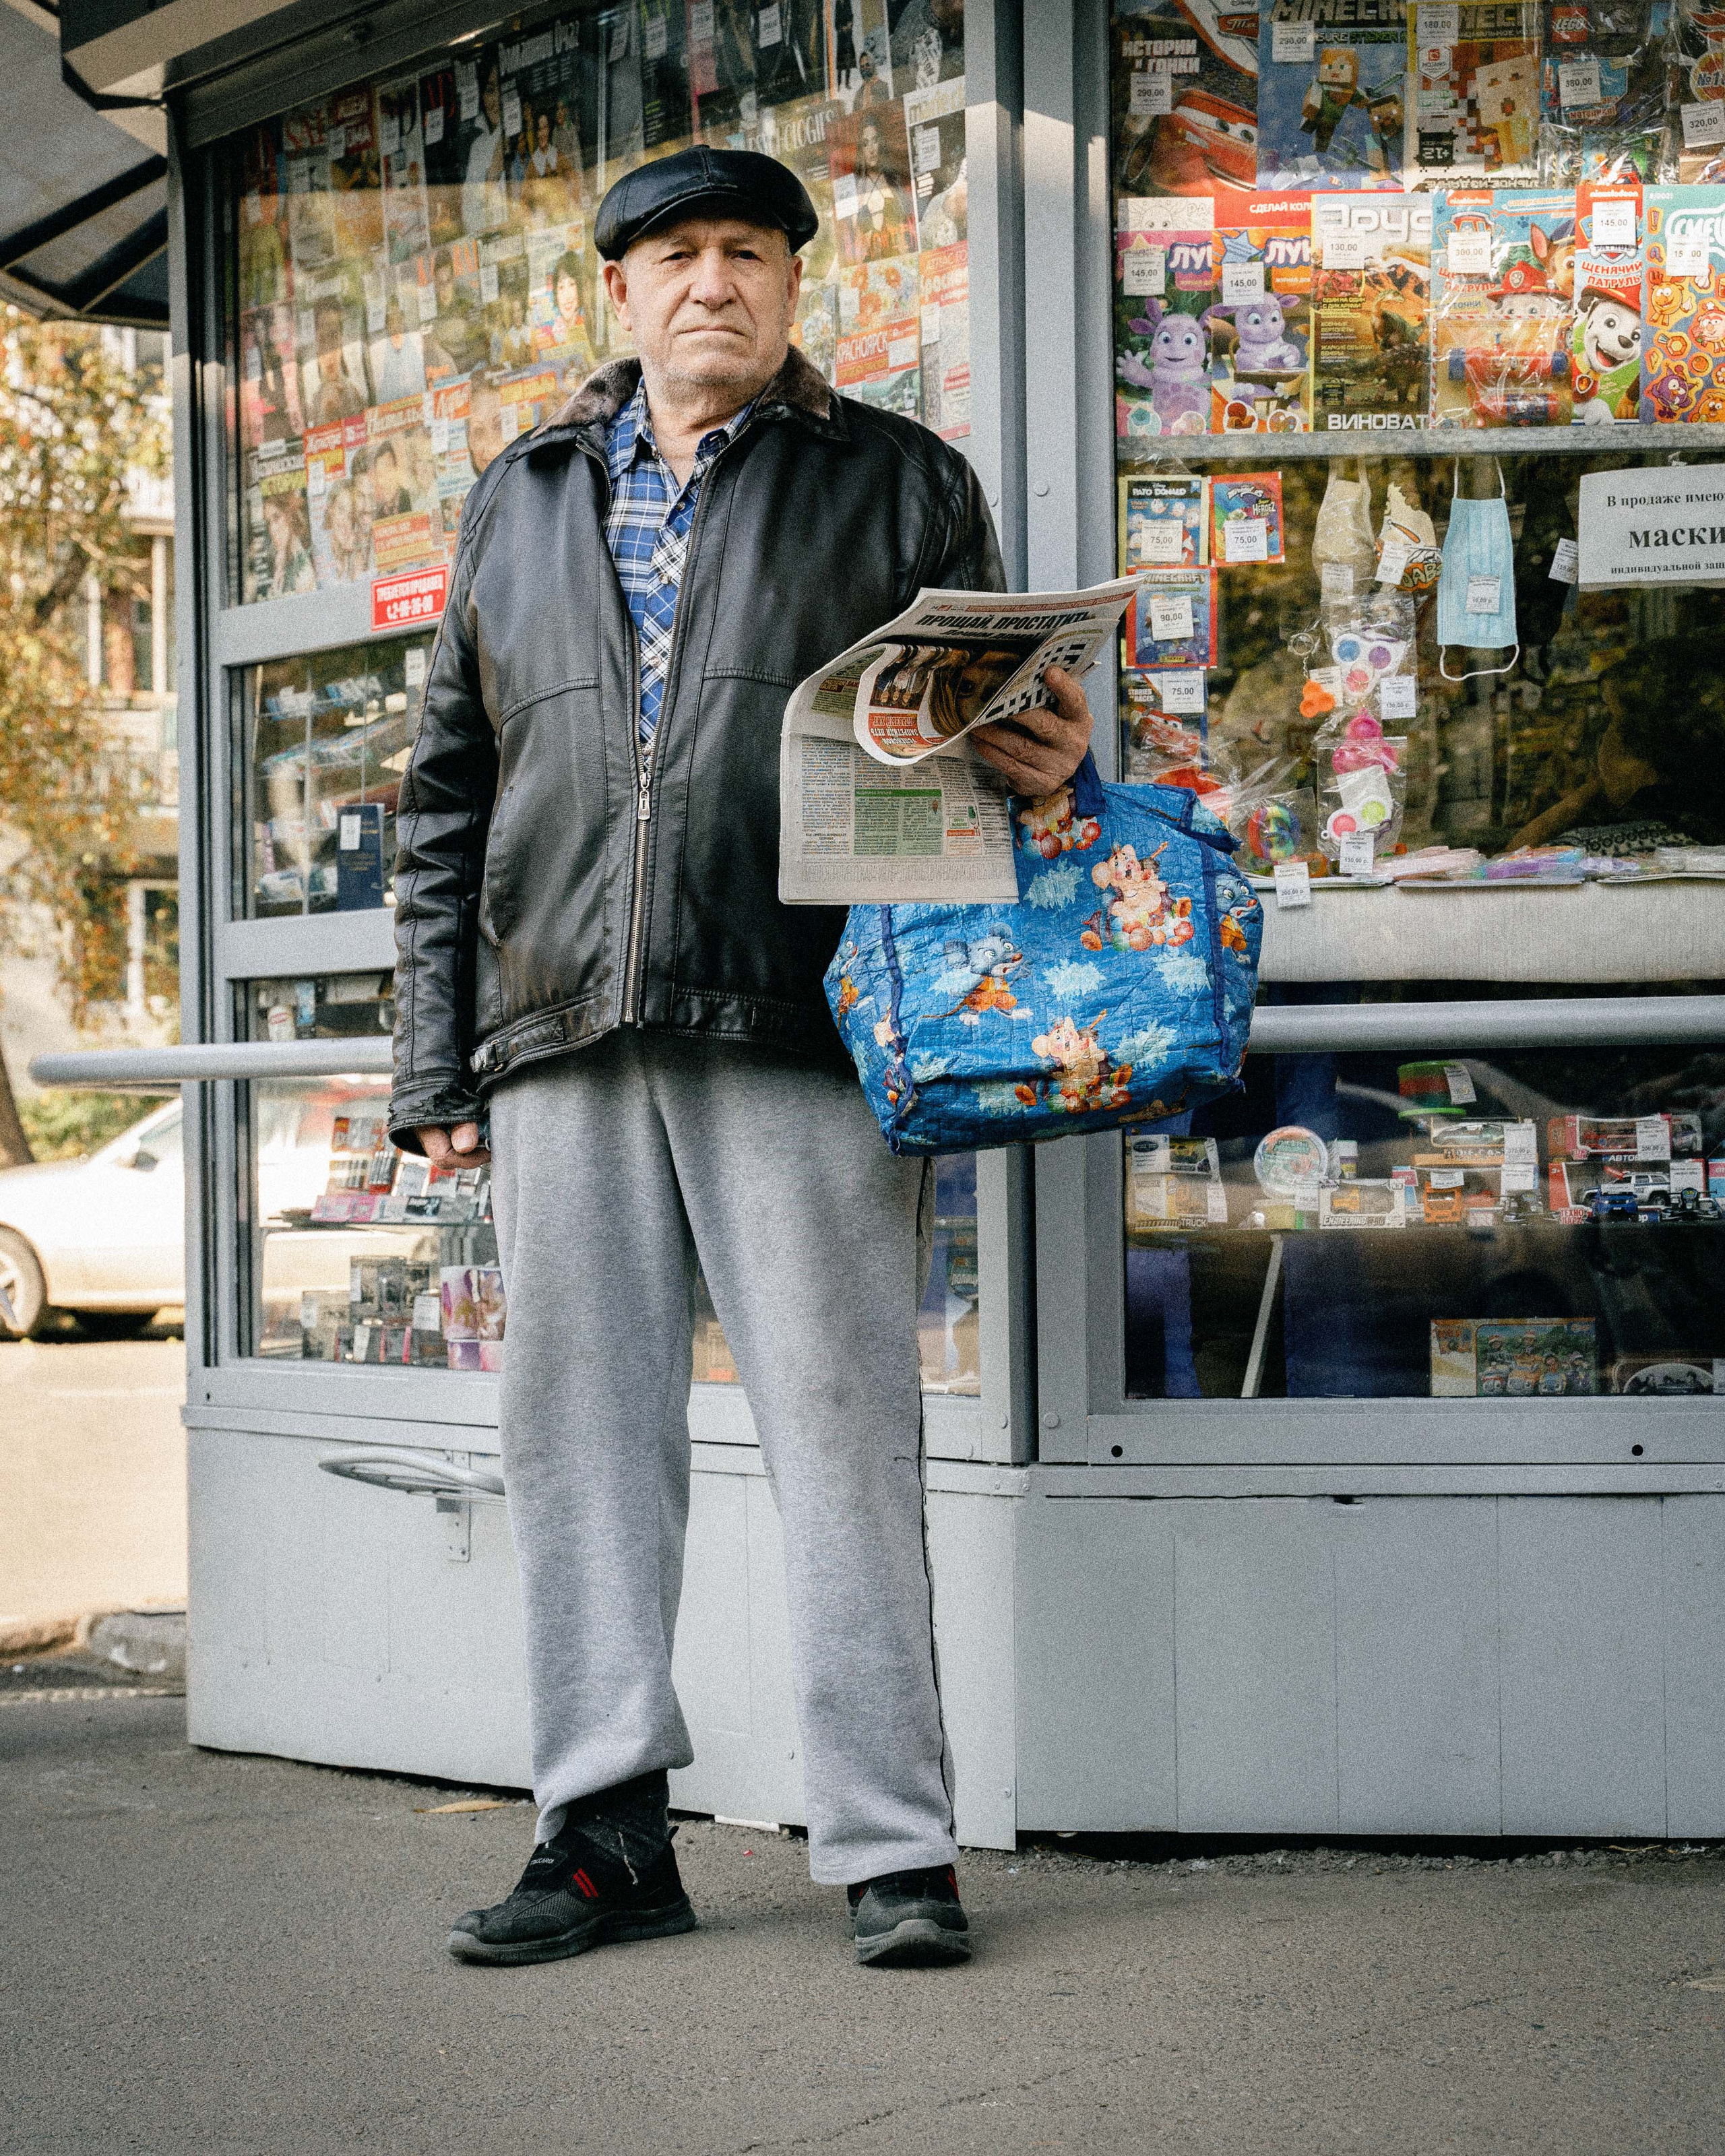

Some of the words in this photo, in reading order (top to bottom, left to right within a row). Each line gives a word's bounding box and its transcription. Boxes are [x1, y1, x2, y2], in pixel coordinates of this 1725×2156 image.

[1689, 117, 1719, 129] 320,00
[1249, 201, 1288, 214] СДЕЛАЙ
[1330, 242, 1358, 253] 130,00
[1581, 260, 1643, 276] ЩЕНЯЧИЙ
[1230, 278, 1257, 288] 145,00
[1588, 274, 1642, 288] ПАТРУЛЬ
[1607, 495, 1617, 507] В
[1621, 494, 1681, 509] продаже
[1150, 536, 1173, 544] 75,00
[1234, 535, 1257, 544] 75,00
[1628, 526, 1725, 549] маски
[1610, 561, 1701, 575] индивидуальной
[914, 613, 997, 631] ПРОЩАЙ,
[1160, 612, 1183, 622] 90,00
[1172, 687, 1195, 695] 75,00
[1180, 1217, 1208, 1228] TRUCK
